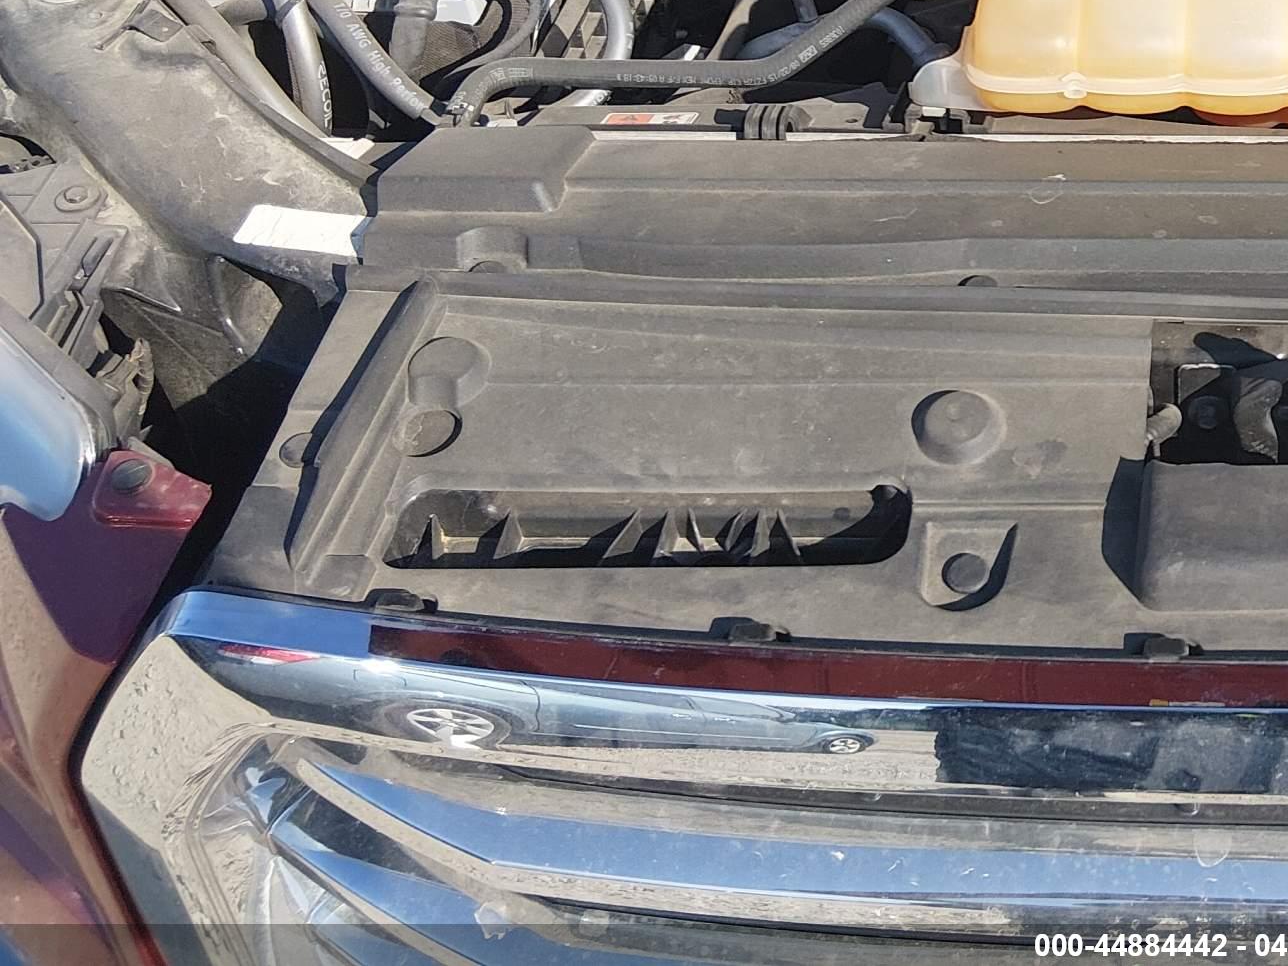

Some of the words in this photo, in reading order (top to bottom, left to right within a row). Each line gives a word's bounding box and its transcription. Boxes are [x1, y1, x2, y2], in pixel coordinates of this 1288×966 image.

[333, 3, 353, 20] 1/0
[345, 23, 373, 50] AWG
[367, 49, 394, 78] High
[317, 59, 333, 129] RECOIL
